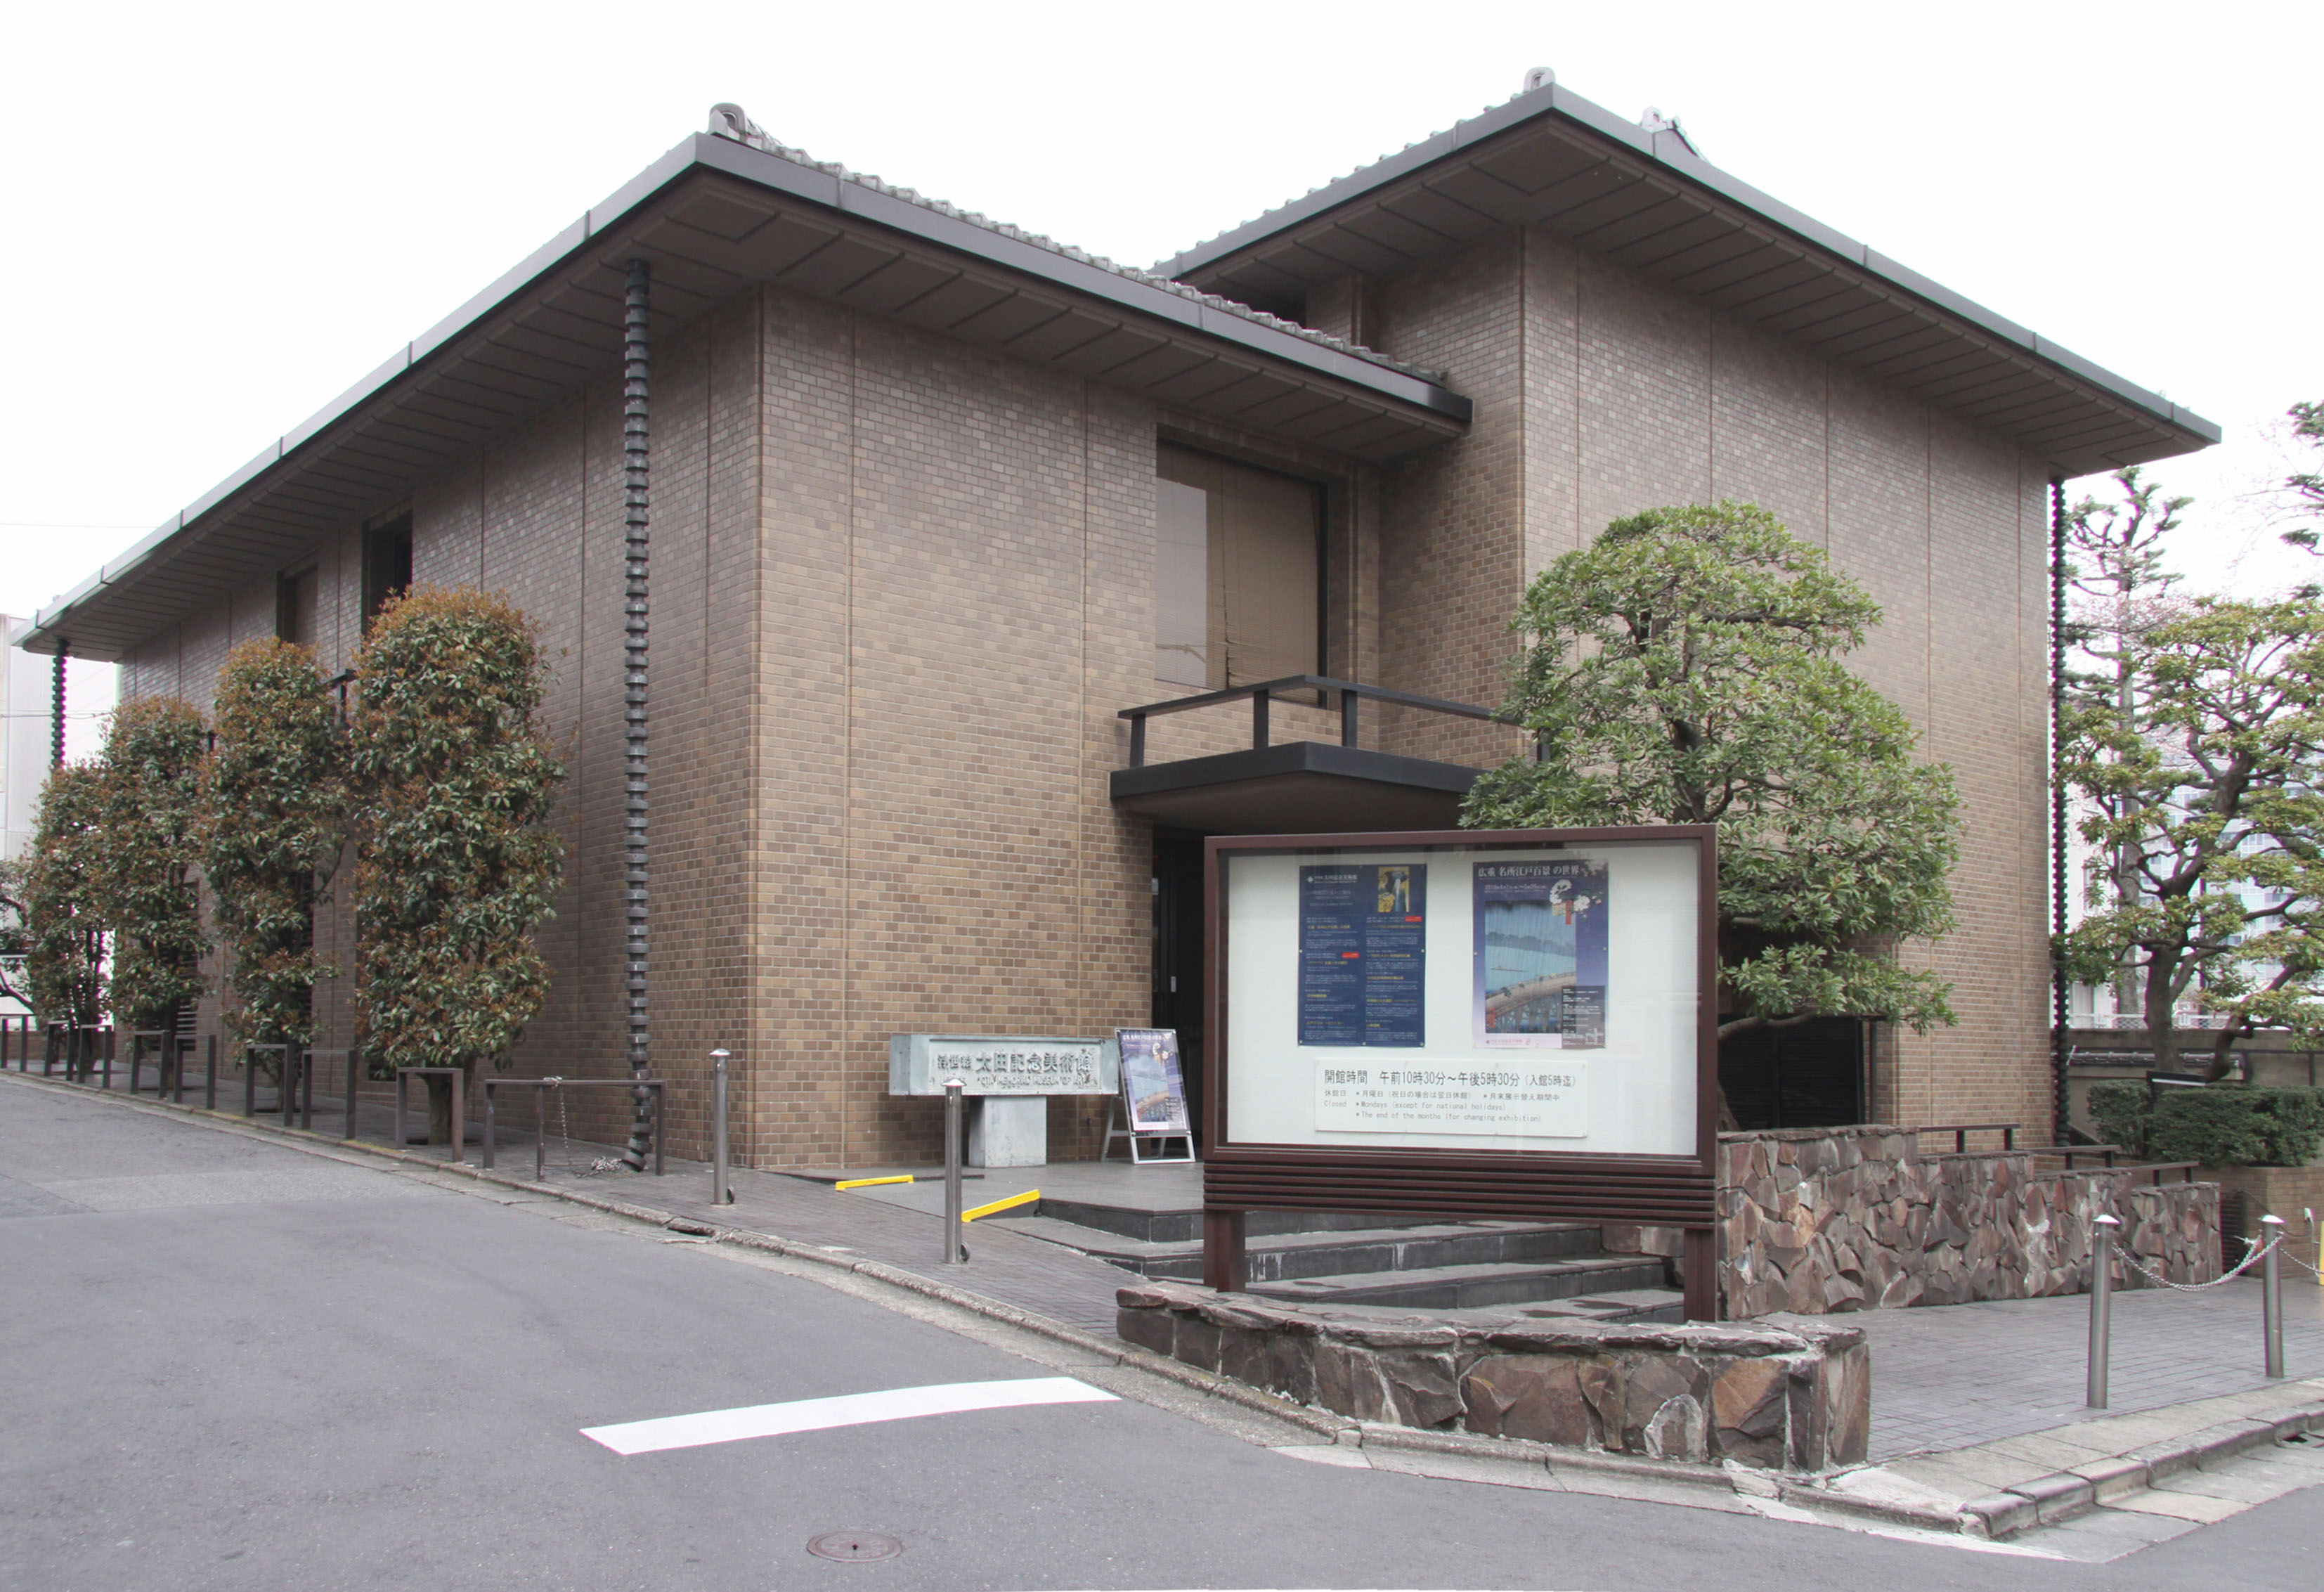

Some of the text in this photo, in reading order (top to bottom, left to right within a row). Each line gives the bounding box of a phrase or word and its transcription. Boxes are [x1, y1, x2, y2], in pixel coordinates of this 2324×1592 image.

[1499, 866, 1550, 876] 名所江戸百景
[1552, 865, 1579, 875] の世界
[975, 1052, 1091, 1073] 太田記念美術館
[1324, 1069, 1368, 1085] 開館時間
[1464, 1113, 1495, 1122] changing
